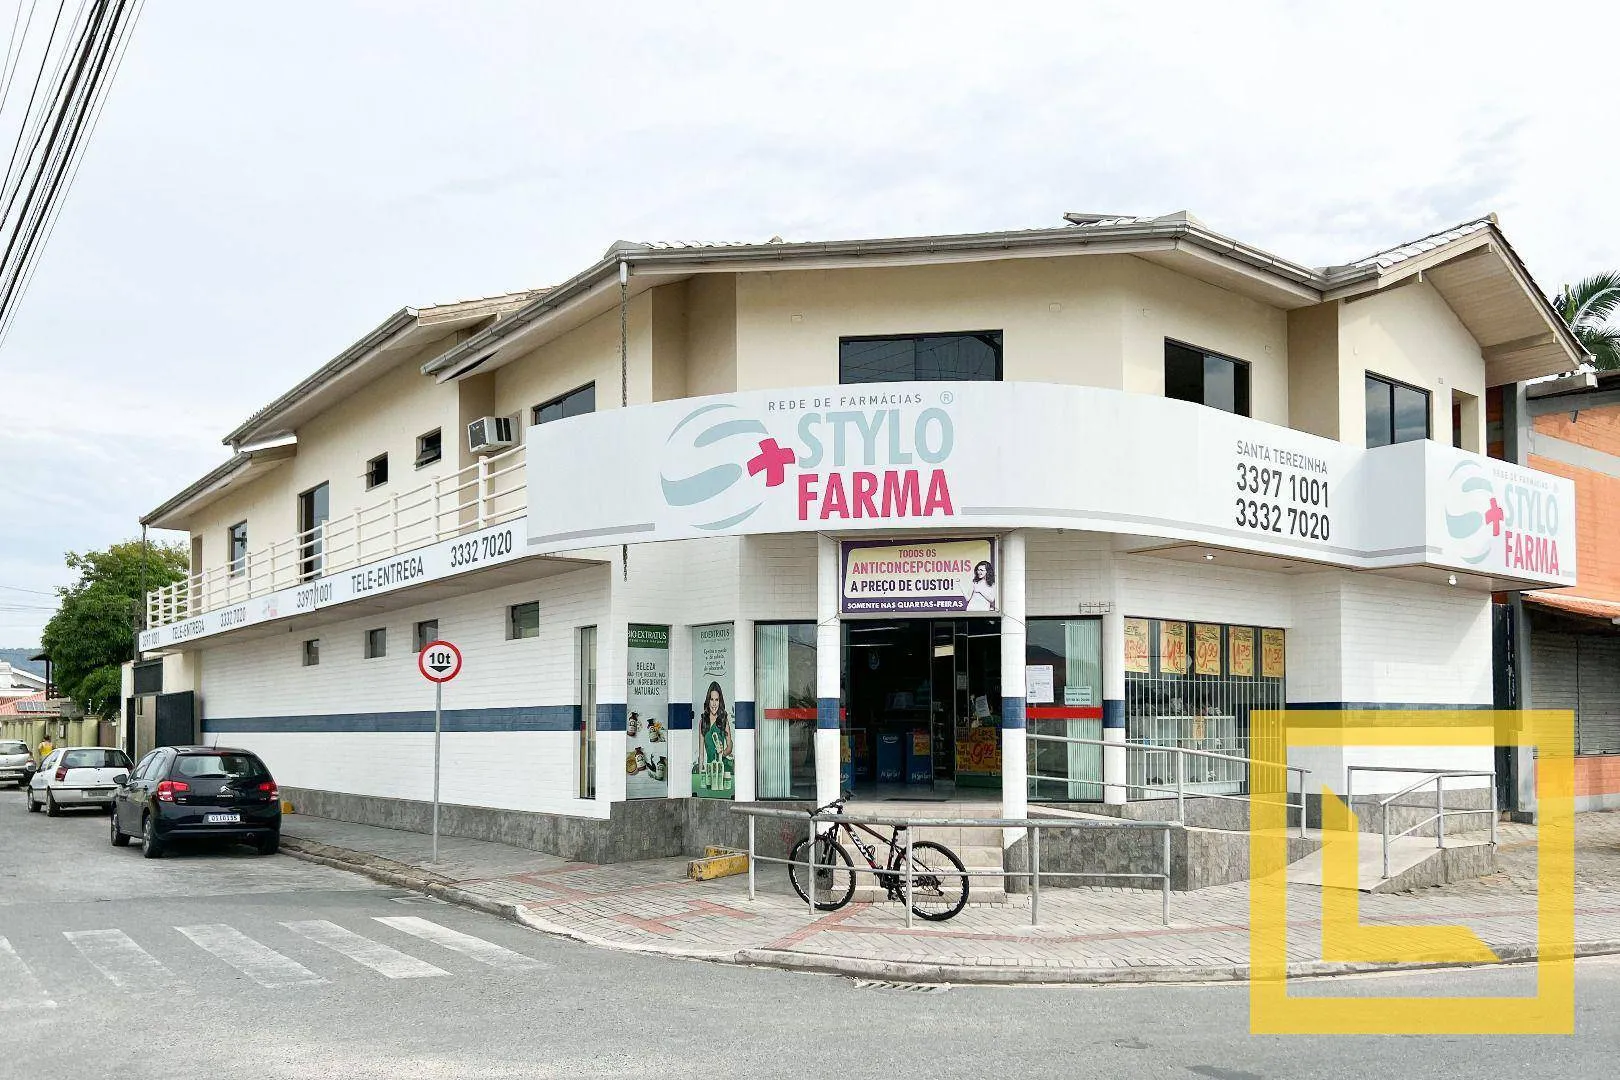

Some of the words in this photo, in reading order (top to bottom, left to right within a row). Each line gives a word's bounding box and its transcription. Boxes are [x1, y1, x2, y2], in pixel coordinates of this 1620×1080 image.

[768, 400, 806, 411] REDE
[814, 398, 831, 408] DE
[840, 393, 922, 406] FARMÁCIAS
[798, 407, 954, 469] STYLO
[1236, 440, 1271, 462] SANTA
[1273, 449, 1328, 475] TEREZINHA
[798, 469, 954, 520] FARMA
[1237, 462, 1282, 498] 3397
[1289, 474, 1328, 508] 1001
[1236, 498, 1282, 533] 3332
[1287, 507, 1330, 541] 7020
[1505, 483, 1559, 537] STYLO
[852, 559, 972, 575] ANTICONCEPCIONAIS
[899, 549, 924, 558] TODOS
[926, 549, 937, 558] OS
[1505, 530, 1559, 576] FARMA
[172, 618, 205, 641] TELE-ENTREGA
[297, 589, 314, 609] 3397
[315, 582, 333, 603] 1001
[352, 556, 424, 594] TELE-ENTREGA
[451, 540, 478, 568] 3332
[482, 530, 512, 560] 7020
[850, 580, 859, 592] A
[861, 579, 896, 594] PREÇO
[899, 579, 912, 592] DE
[915, 578, 954, 591] CUSTO!
[897, 600, 963, 609] QUARTAS-FEIRAS
[429, 652, 451, 665] 10t
[636, 661, 656, 671] BELEZA
